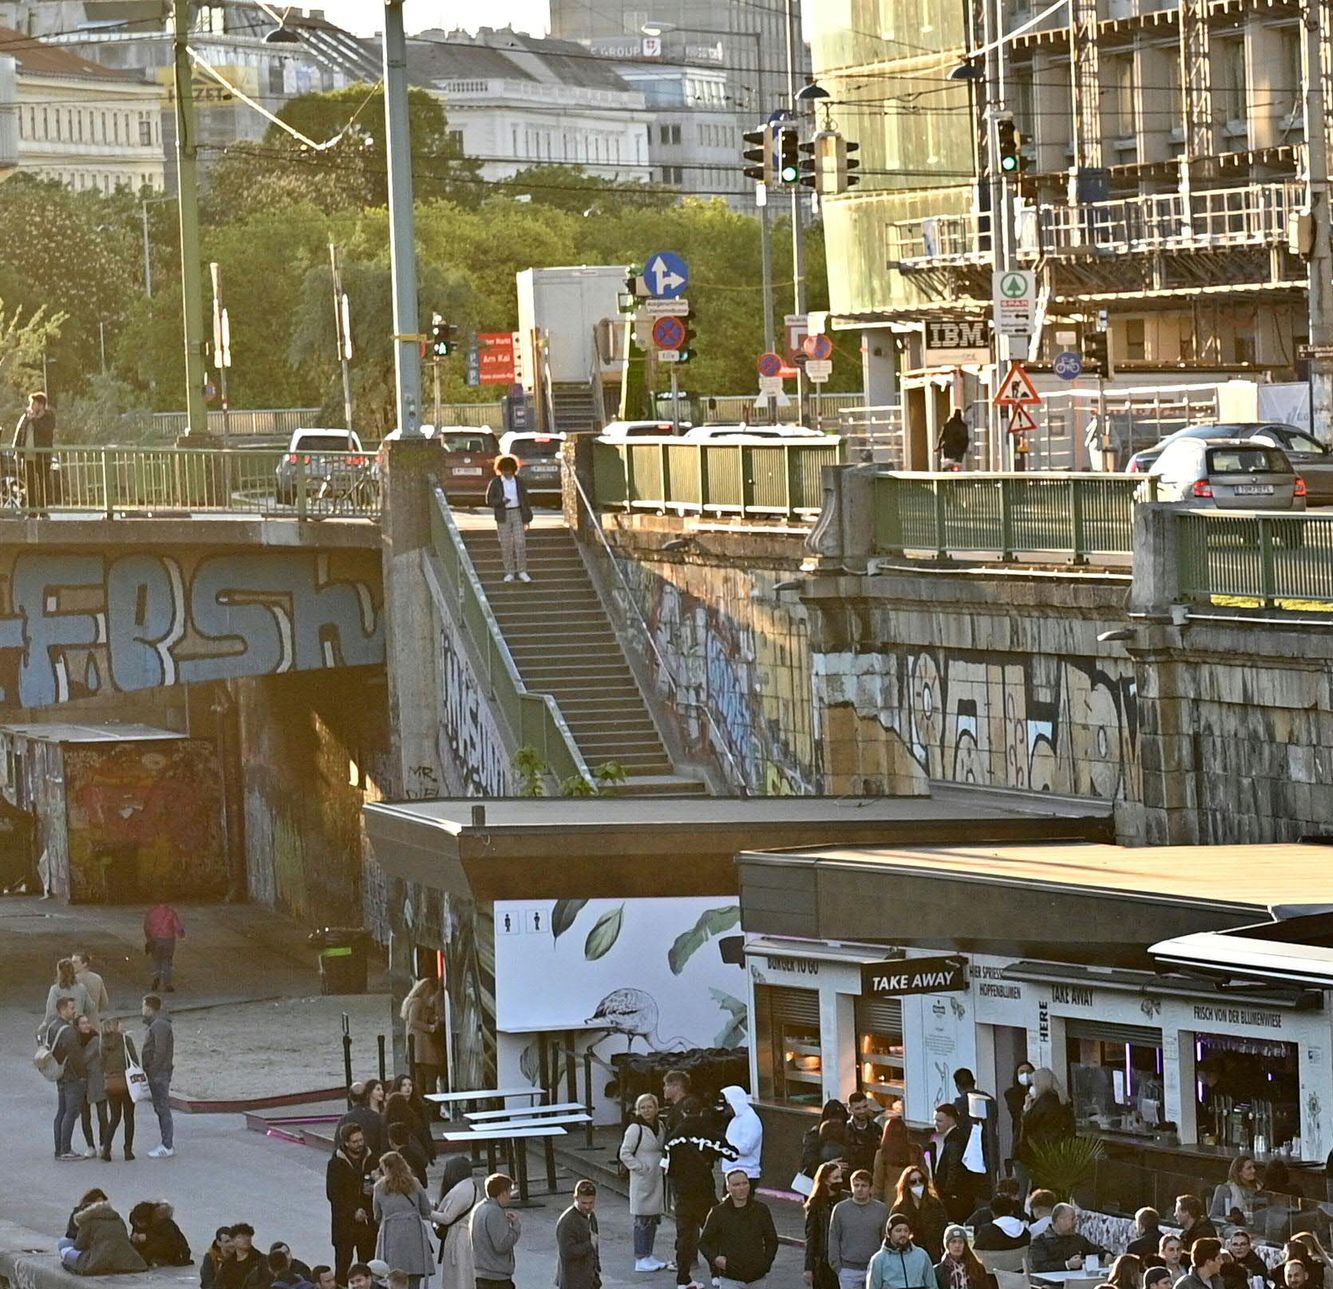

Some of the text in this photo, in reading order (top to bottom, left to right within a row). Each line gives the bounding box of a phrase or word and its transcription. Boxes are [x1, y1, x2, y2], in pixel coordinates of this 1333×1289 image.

[929, 322, 984, 347] IBM
[872, 971, 955, 992] TAKE AWAY
[1051, 984, 1094, 1007] TAKE AWAY
[1038, 1000, 1049, 1043] HERE
[1193, 1005, 1214, 1021] FRISCH
